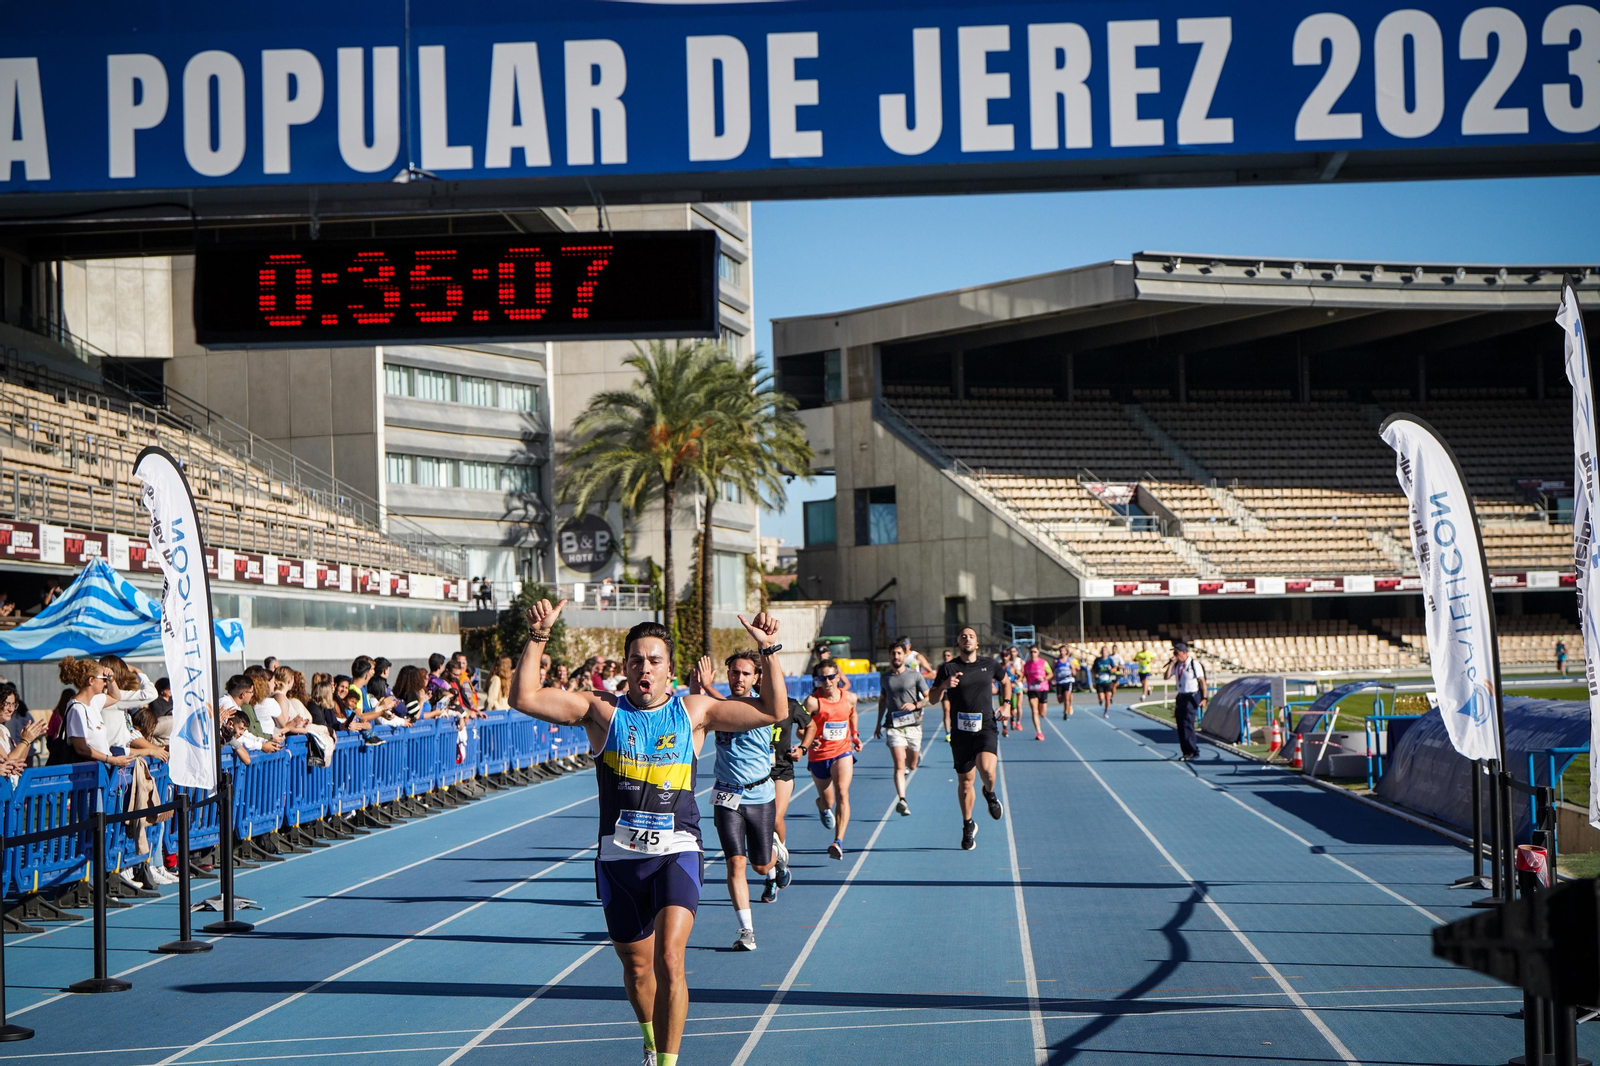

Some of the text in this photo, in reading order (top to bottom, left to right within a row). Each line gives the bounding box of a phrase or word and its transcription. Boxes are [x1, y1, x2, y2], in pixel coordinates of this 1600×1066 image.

[107, 40, 628, 179] POPULAR
[685, 32, 823, 162] DE
[879, 16, 1235, 155] JEREZ
[1292, 4, 1600, 141] 2023
[259, 244, 615, 327] 0:35:07
[561, 530, 610, 554] B&B
[569, 553, 605, 564] HOTELS
[963, 720, 977, 728] 666
[829, 729, 843, 737] 555
[618, 749, 680, 762] RUBYSAN
[716, 791, 735, 802] 687
[628, 828, 660, 846] 745
